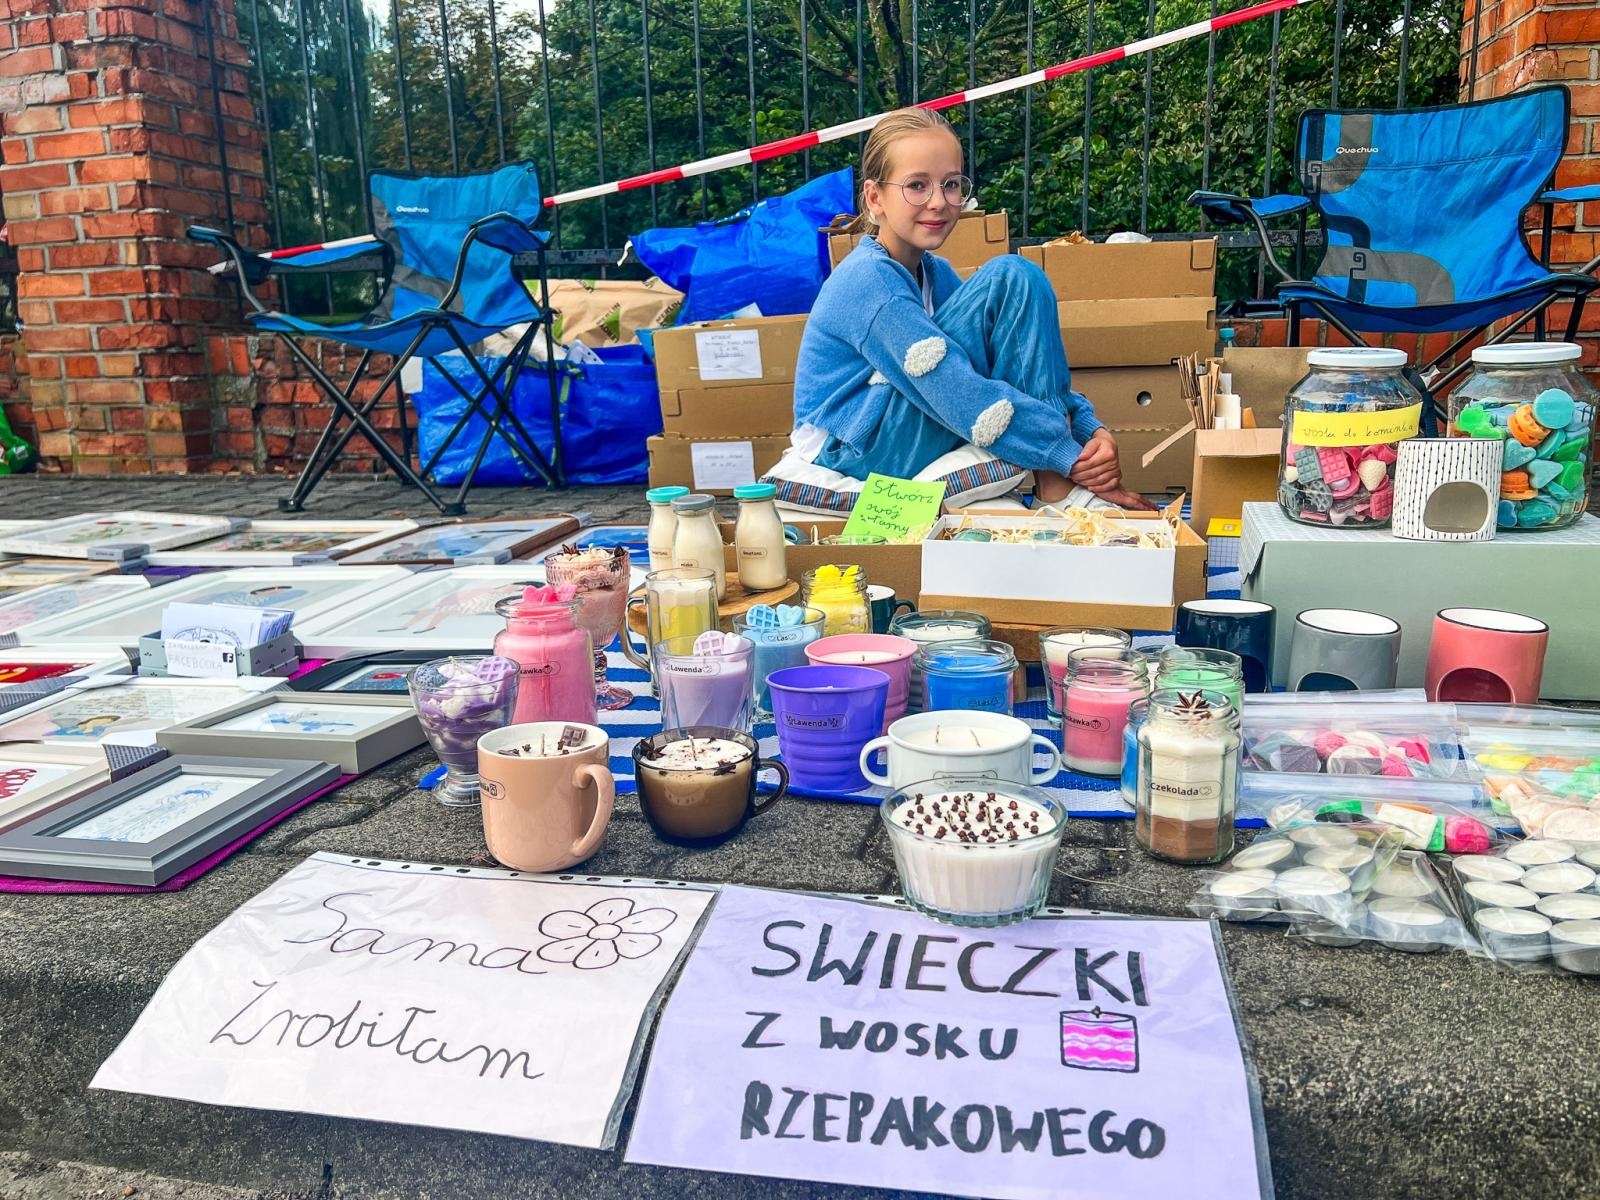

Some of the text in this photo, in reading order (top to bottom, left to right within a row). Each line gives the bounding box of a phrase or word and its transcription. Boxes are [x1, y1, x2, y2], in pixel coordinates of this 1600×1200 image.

[1335, 146, 1379, 154] Quechua
[873, 479, 934, 503] Stwórz
[670, 664, 702, 673] Lawenda
[793, 718, 828, 727] Lawenda
[1150, 782, 1199, 796] Czekolada
[284, 892, 548, 974] Sama
[751, 920, 1148, 1007] SWIECZKI
[741, 1011, 1018, 1060] Z WOSKU
[741, 1080, 1166, 1159] RZEPAKOWEGO
